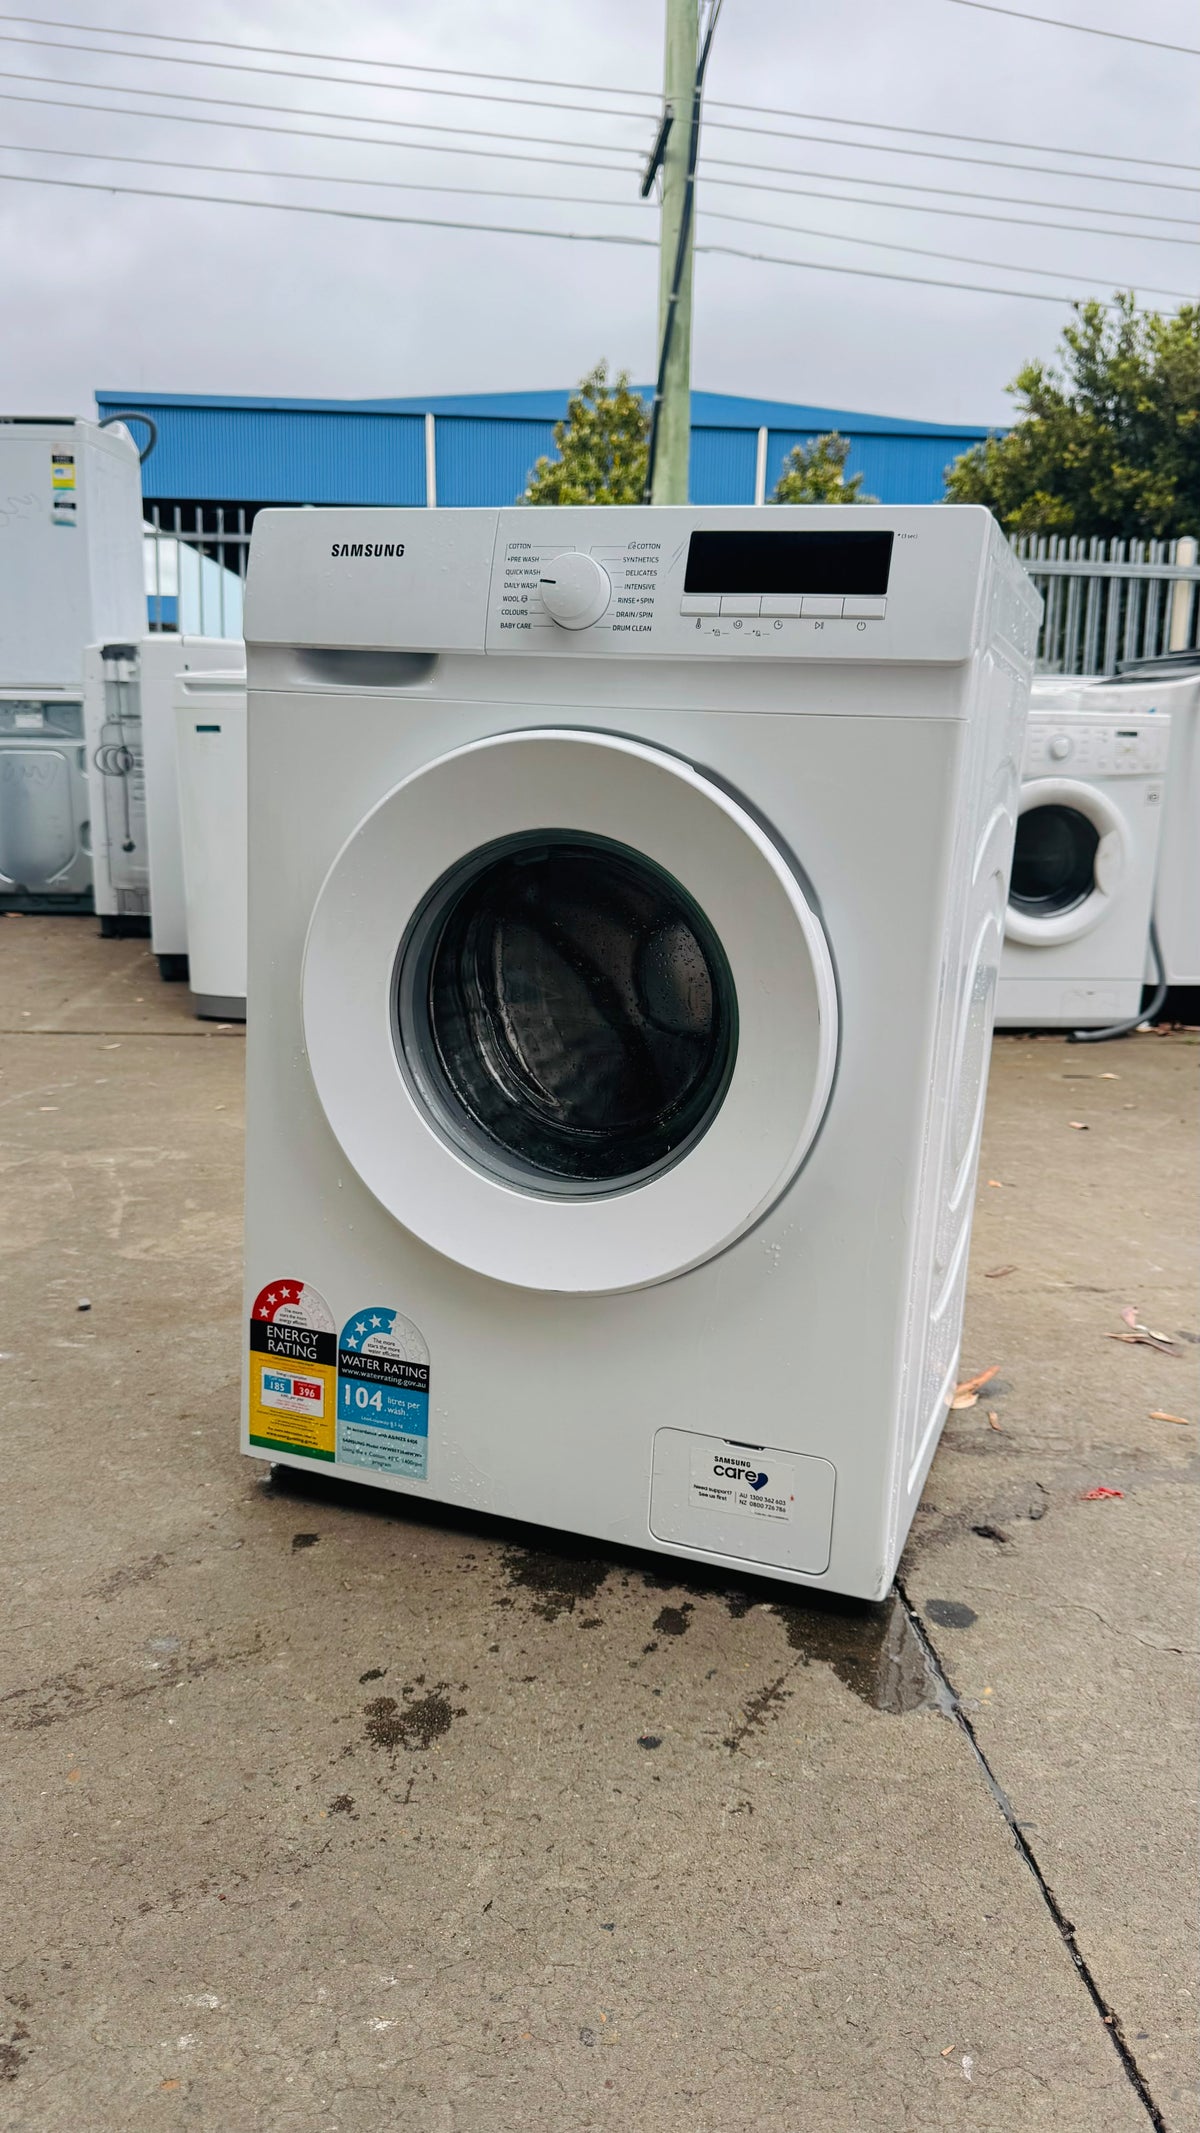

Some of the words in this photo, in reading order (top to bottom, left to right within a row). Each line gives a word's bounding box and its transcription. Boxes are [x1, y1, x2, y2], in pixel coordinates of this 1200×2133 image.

[331, 544, 405, 557] SAMSUNG
[612, 624, 631, 632] DRUM
[266, 1325, 319, 1346] ENERGY
[268, 1340, 317, 1360] RATING
[341, 1354, 381, 1371] WATER
[384, 1362, 428, 1380] RATING
[341, 1367, 427, 1389] www.waterrating.gov.au
[270, 1381, 285, 1392] 185
[299, 1387, 315, 1398] 396
[345, 1384, 383, 1412] 104
[387, 1396, 406, 1407] litres
[407, 1401, 421, 1410] per
[714, 1455, 751, 1468] SAMSUNG
[713, 1465, 757, 1482] care
[708, 1487, 733, 1496] support?
[750, 1494, 764, 1502] 1300
[749, 1501, 764, 1509] 0800
